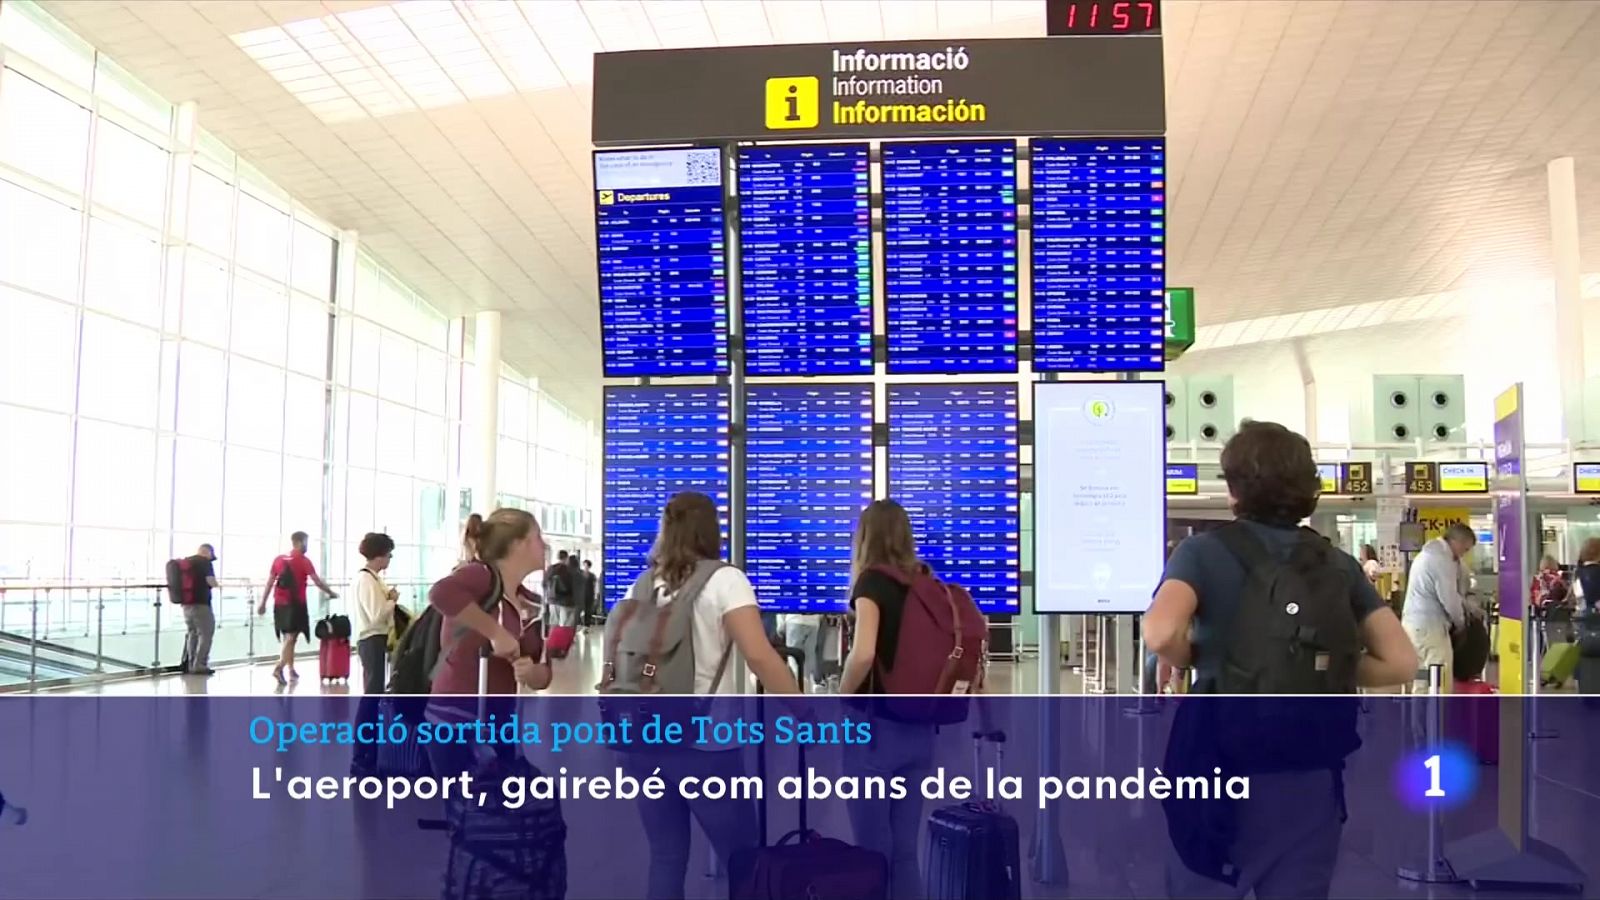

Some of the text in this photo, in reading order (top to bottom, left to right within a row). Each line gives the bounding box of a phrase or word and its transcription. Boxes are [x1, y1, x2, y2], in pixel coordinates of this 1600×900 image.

[832, 46, 969, 72] Informació
[832, 75, 943, 97] Information
[832, 99, 986, 125] Información
[617, 192, 671, 204] Departures
[1345, 480, 1369, 492] 452
[1409, 480, 1433, 492] 453
